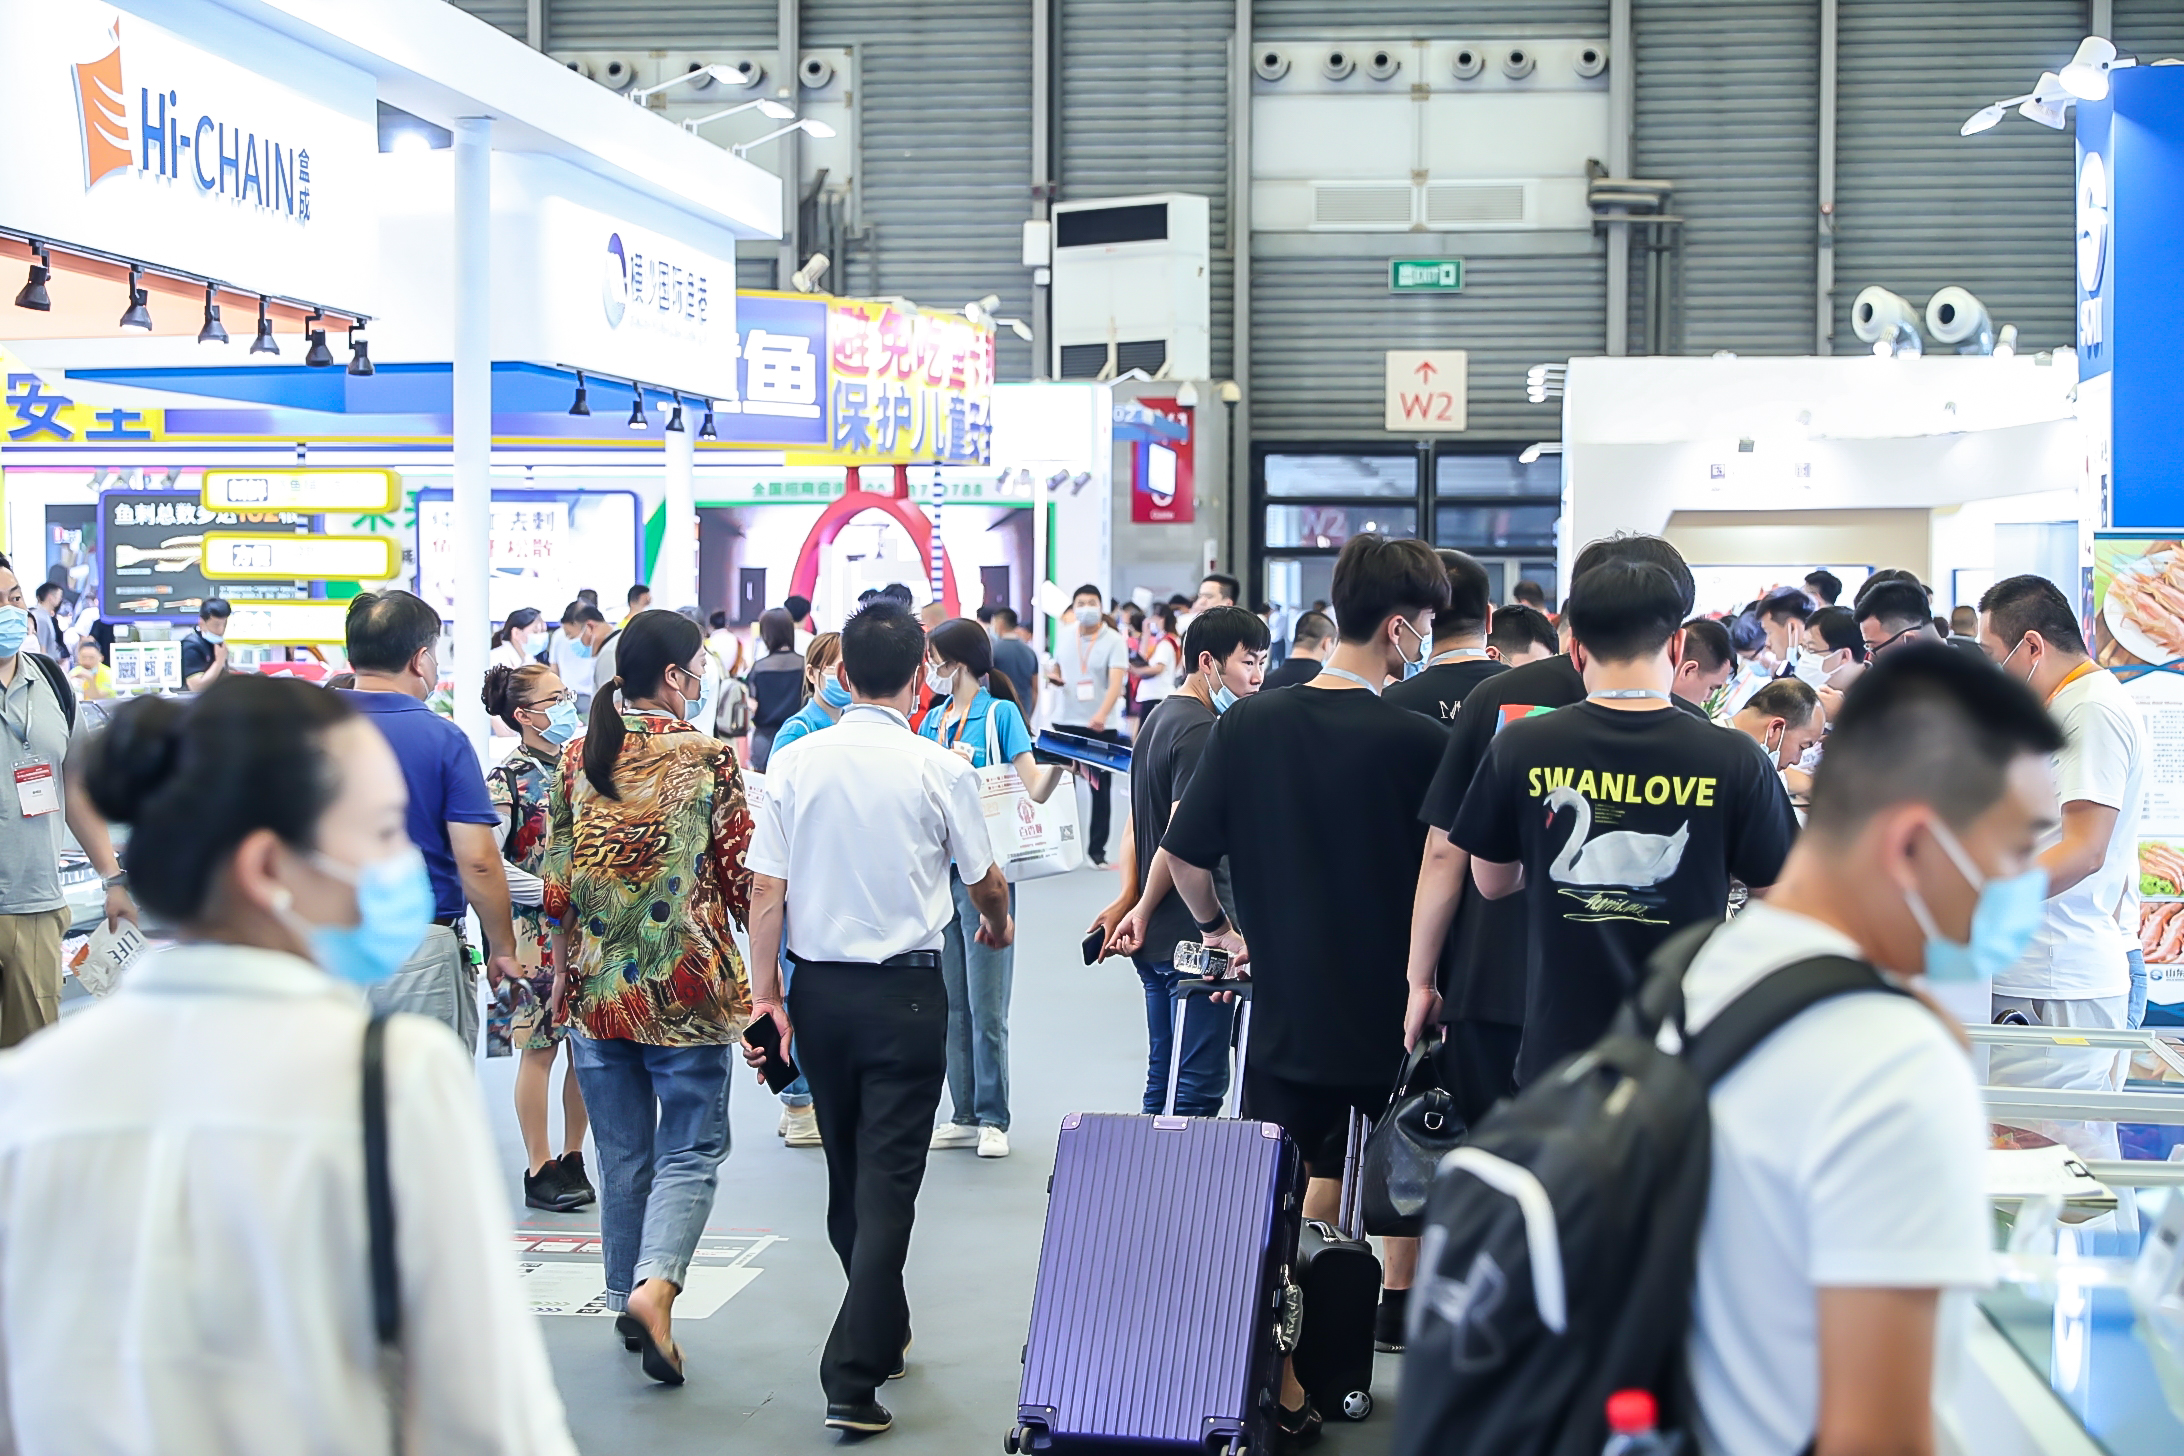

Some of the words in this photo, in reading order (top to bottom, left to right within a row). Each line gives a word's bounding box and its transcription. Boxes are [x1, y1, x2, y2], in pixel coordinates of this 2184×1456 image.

[142, 87, 294, 216] Hi-CHAIN
[1400, 392, 1454, 421] W2
[1528, 766, 1718, 807] SWANLOVE
